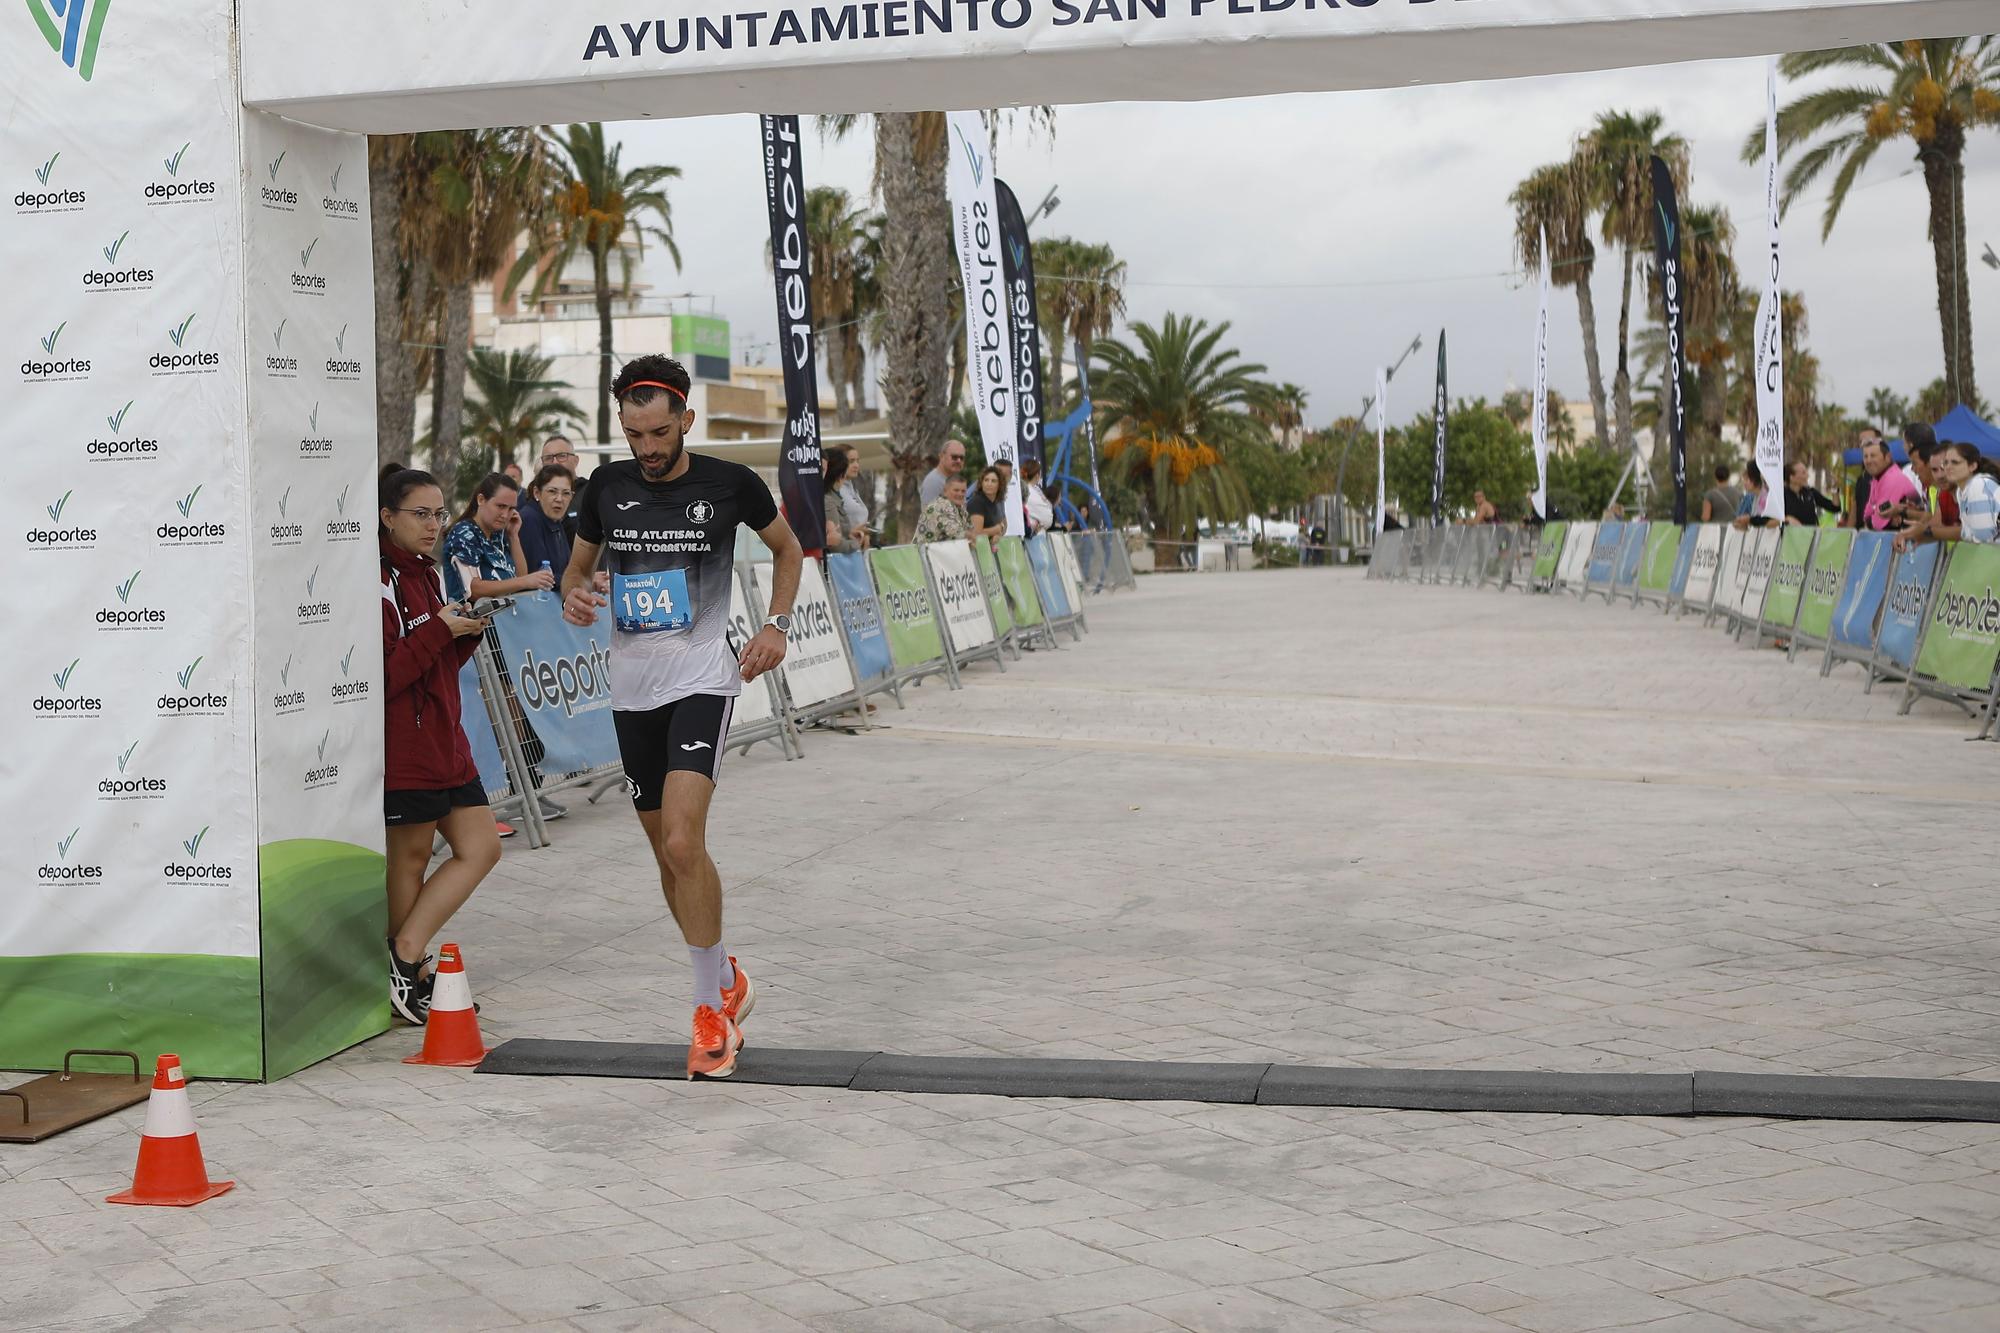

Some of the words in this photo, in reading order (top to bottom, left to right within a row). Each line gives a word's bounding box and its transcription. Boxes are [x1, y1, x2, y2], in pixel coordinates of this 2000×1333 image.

[583, 0, 1031, 60] AYUNTAMIENTO
[15, 189, 85, 208] deportes
[145, 180, 214, 200] deportes
[261, 185, 297, 204] deportes
[323, 196, 358, 213] deportes
[83, 268, 153, 287] deportes
[291, 272, 325, 290] deportes
[21, 358, 90, 377] deportes
[149, 351, 219, 370] deportes
[267, 354, 297, 371] deportes
[326, 358, 360, 375] deportes
[87, 438, 158, 457] deportes
[300, 437, 332, 454] deportes
[27, 527, 96, 545] deportes
[157, 522, 225, 541] deportes
[271, 523, 302, 541] deportes
[327, 520, 360, 537] deportes
[613, 528, 638, 539] CLUB
[641, 530, 705, 540] ATLETISMO
[645, 543, 711, 553] TORREVIEJA
[940, 565, 980, 610] deportes
[298, 601, 330, 620] deportes
[622, 589, 674, 617] 194
[885, 583, 930, 630] deportes
[96, 608, 165, 626] deportes
[332, 680, 368, 699] deportes
[33, 696, 101, 714] deportes
[157, 693, 227, 712] deportes
[274, 690, 305, 710] deportes
[304, 764, 338, 784] deportes
[98, 777, 166, 796] deportes
[38, 864, 102, 882] deportes
[164, 862, 231, 881] deportes
